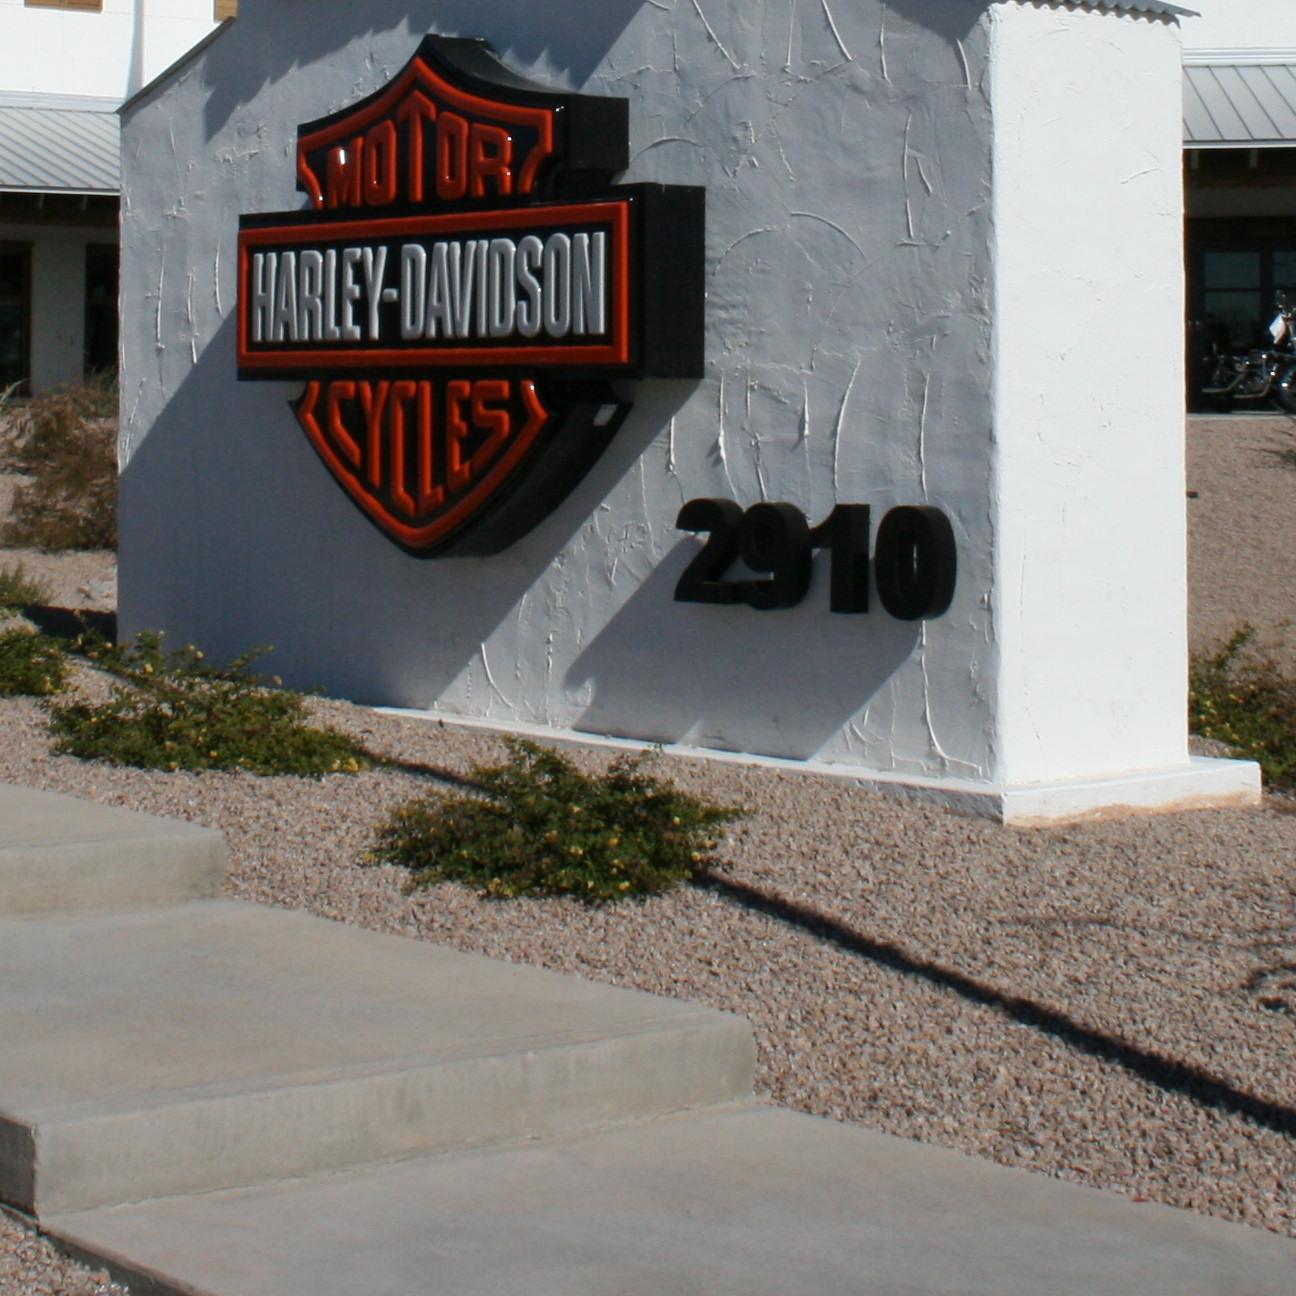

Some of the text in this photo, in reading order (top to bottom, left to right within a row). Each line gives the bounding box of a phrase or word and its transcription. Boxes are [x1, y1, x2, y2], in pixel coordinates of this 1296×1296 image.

[327, 90, 512, 208] MOTOR
[252, 231, 605, 342] HARLEY-DAVIDSON
[328, 379, 510, 518] CYCLES
[674, 498, 957, 620] 2910
